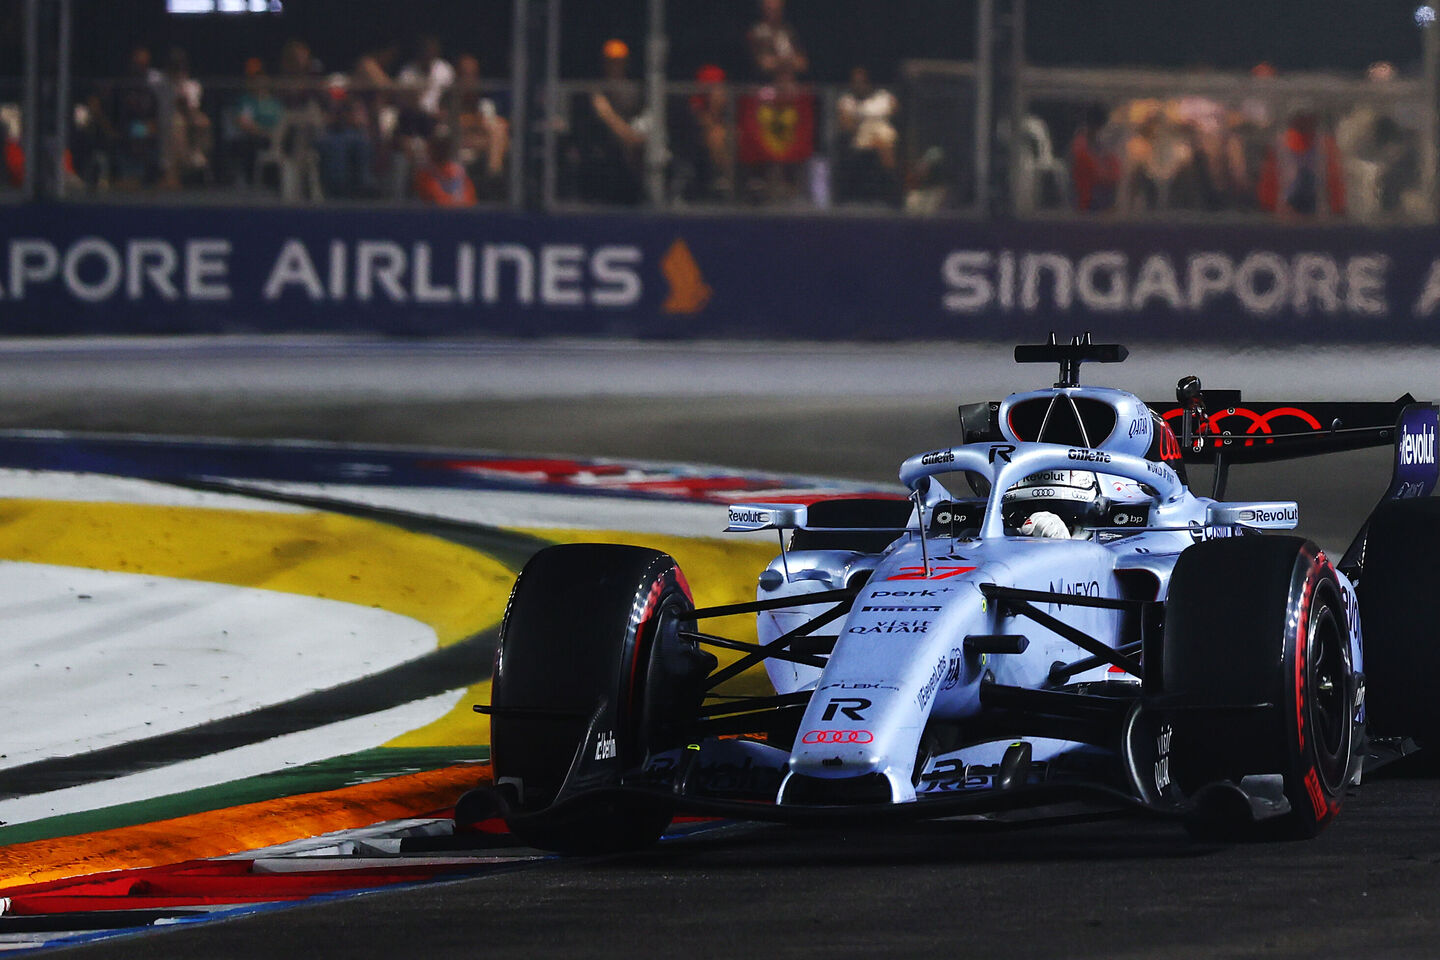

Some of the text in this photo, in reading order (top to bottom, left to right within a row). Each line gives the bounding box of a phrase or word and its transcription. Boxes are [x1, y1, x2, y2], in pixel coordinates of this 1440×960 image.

[0, 240, 641, 305] PORE AIRLINES
[942, 250, 1389, 314] SINGAPORE
[921, 449, 955, 465] Gillette
[1068, 448, 1112, 464] Gillette
[728, 509, 760, 523] Revolut
[953, 514, 967, 523] bp
[1130, 515, 1143, 523] bp
[1256, 510, 1297, 523] Revolut
[887, 566, 977, 581] 27
[848, 626, 928, 635] QATAR
[822, 697, 872, 721] R
